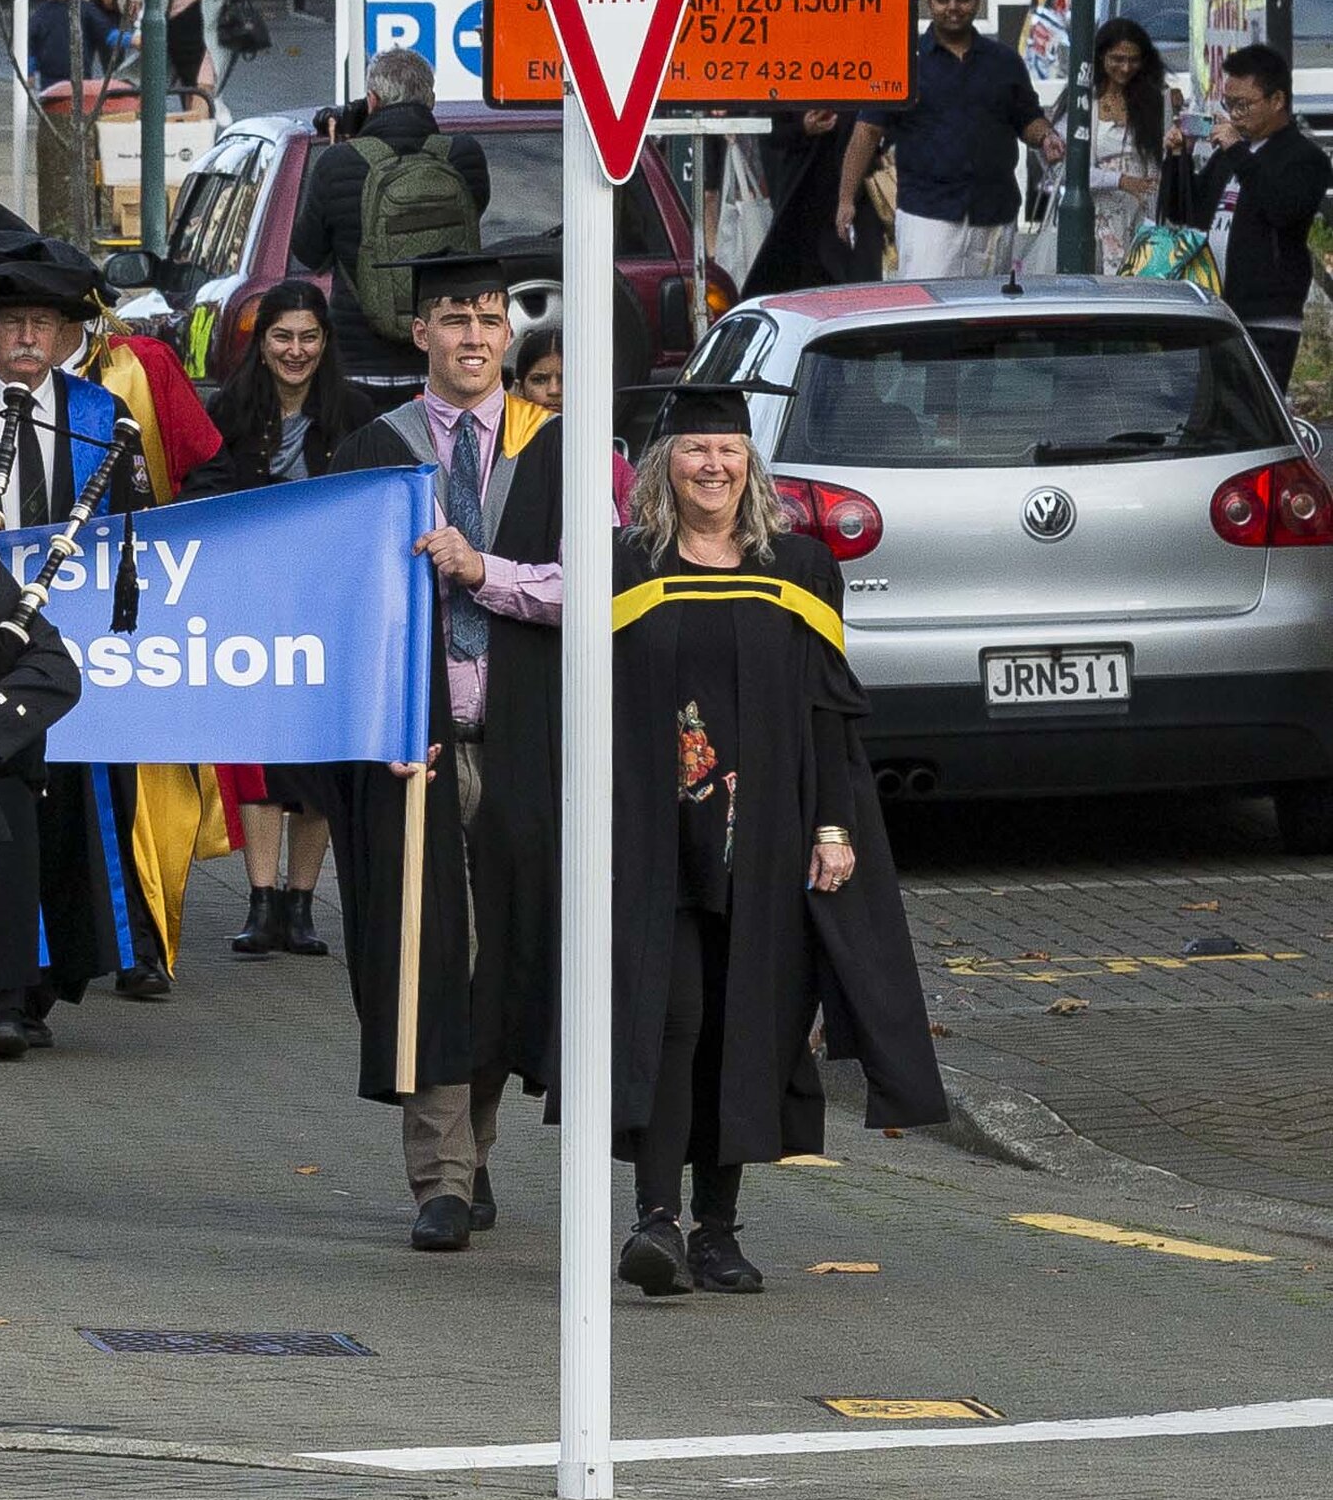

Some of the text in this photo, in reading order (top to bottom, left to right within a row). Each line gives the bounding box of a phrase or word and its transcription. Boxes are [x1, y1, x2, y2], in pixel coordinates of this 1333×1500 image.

[703, 60, 754, 81] 027
[756, 60, 803, 81] 432
[810, 60, 873, 81] 0420
[848, 577, 890, 593] GTI
[992, 659, 1120, 698] JRN511
